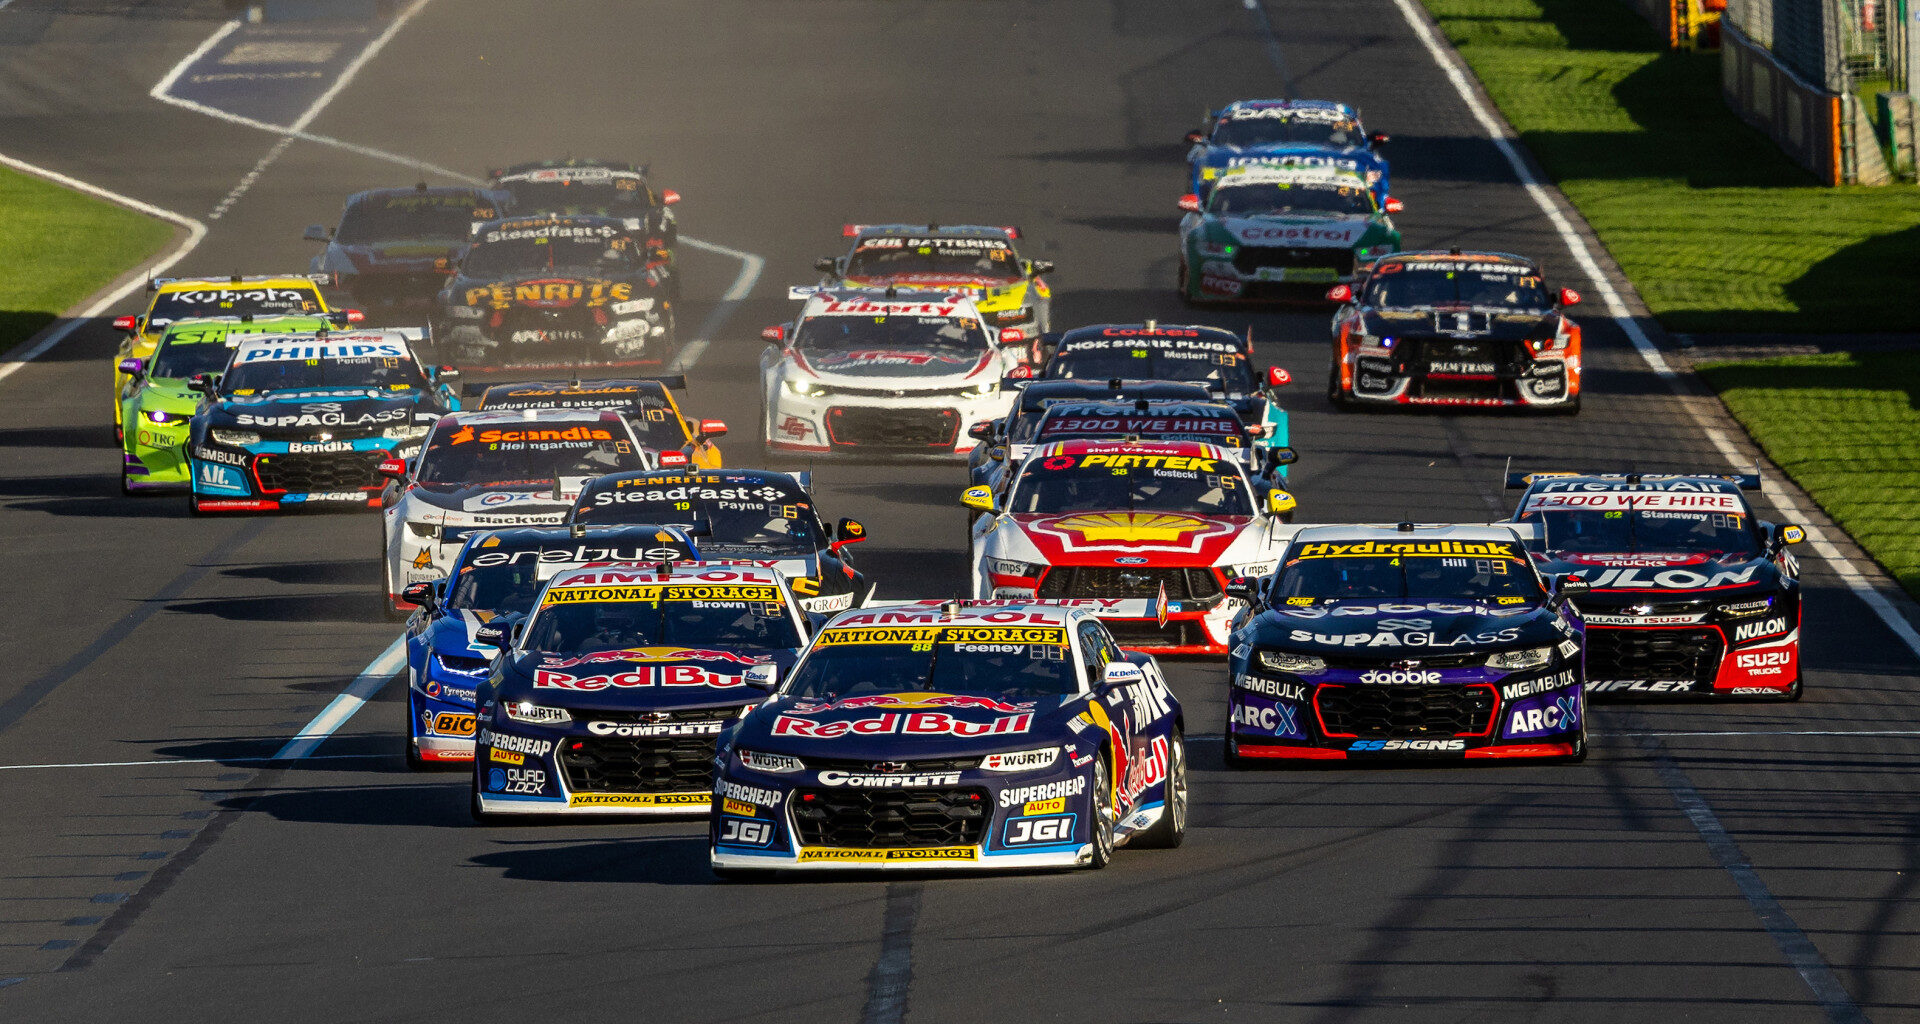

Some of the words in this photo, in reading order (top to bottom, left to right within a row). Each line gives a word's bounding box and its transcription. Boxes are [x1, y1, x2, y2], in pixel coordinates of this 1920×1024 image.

[486, 225, 593, 243] Steadfast
[1242, 227, 1351, 241] Castrol
[824, 302, 955, 316] Liberty
[1102, 328, 1199, 337] Coates
[245, 345, 401, 362] PHILIPS
[1176, 340, 1237, 353] PLUGS
[336, 357, 371, 365] Percat
[1163, 351, 1209, 360] Mostert
[483, 401, 555, 411] Industrial
[236, 408, 407, 427] SUPAGLASS
[1048, 419, 1119, 431] 1300
[1126, 420, 1161, 431] WE
[1173, 421, 1233, 432] HIRE
[152, 432, 175, 447] TRG
[479, 426, 612, 443] Scandia
[289, 441, 355, 454] Bendix
[489, 442, 498, 451] 8
[1128, 447, 1179, 455] V-Power
[1079, 455, 1222, 472] PIRTEK
[616, 475, 721, 488] PENRITE
[1111, 468, 1128, 476] 38
[1153, 468, 1198, 480] Kostecki
[1544, 481, 1723, 493] PremiAir
[595, 486, 750, 506] Steadfast
[1531, 495, 1608, 508] 1300
[1617, 495, 1661, 506] WE
[1669, 496, 1733, 507] HIRE
[674, 502, 690, 511] 19
[719, 501, 765, 511] Payne
[1604, 511, 1623, 520] 62
[1641, 510, 1708, 522] Stanaway
[1300, 541, 1513, 556] Hydraulink
[999, 562, 1022, 574] mps
[1248, 565, 1268, 576] mps
[1390, 558, 1400, 567] 4
[1442, 558, 1467, 568] Hill
[562, 572, 772, 587] AMPOL
[1555, 567, 1759, 589] ULON
[549, 588, 656, 602] NATIONAL
[667, 587, 772, 600] STORAGE
[692, 601, 746, 610] Brown
[813, 596, 849, 612] GROVE
[835, 611, 1061, 627] AMPOL
[1585, 616, 1637, 624] ALLARAT
[1644, 616, 1692, 624] ISUZU
[821, 629, 935, 645] NATIONAL
[946, 628, 1059, 643] STORAGE
[1735, 617, 1787, 641] NULON
[1289, 627, 1521, 648] SUPAGLASS
[911, 643, 933, 652] 88
[954, 643, 1025, 655] Feeney
[1736, 651, 1791, 668] ISUZU
[533, 666, 656, 691] Red
[1359, 669, 1442, 686] dabble
[1747, 666, 1782, 676] TRUCKS
[1234, 672, 1306, 701] MGMBULK
[1502, 668, 1576, 701] MGMBULK
[587, 720, 722, 737] COMPLETE
[771, 713, 901, 739] Red
[902, 712, 1035, 738] Bull
[479, 727, 552, 757] SUPERCHEAP
[494, 751, 521, 762] AUTO
[752, 752, 795, 769] WÜRTH
[1003, 751, 1053, 767] WÜRTH
[507, 768, 546, 783] QUAD
[817, 770, 961, 788] COMPLETE
[505, 781, 546, 795] LOCK
[714, 776, 783, 808] SUPERCHEAP
[999, 775, 1086, 809] SUPERCHEAP
[572, 796, 652, 804] NATIONAL
[660, 795, 712, 803] STORA
[726, 800, 753, 813] AUTO
[1028, 801, 1060, 812] AUTO
[721, 820, 772, 844] JGI
[1009, 818, 1071, 844] JGI
[801, 850, 884, 859] NATIONAL
[891, 849, 971, 858] STORAGE
